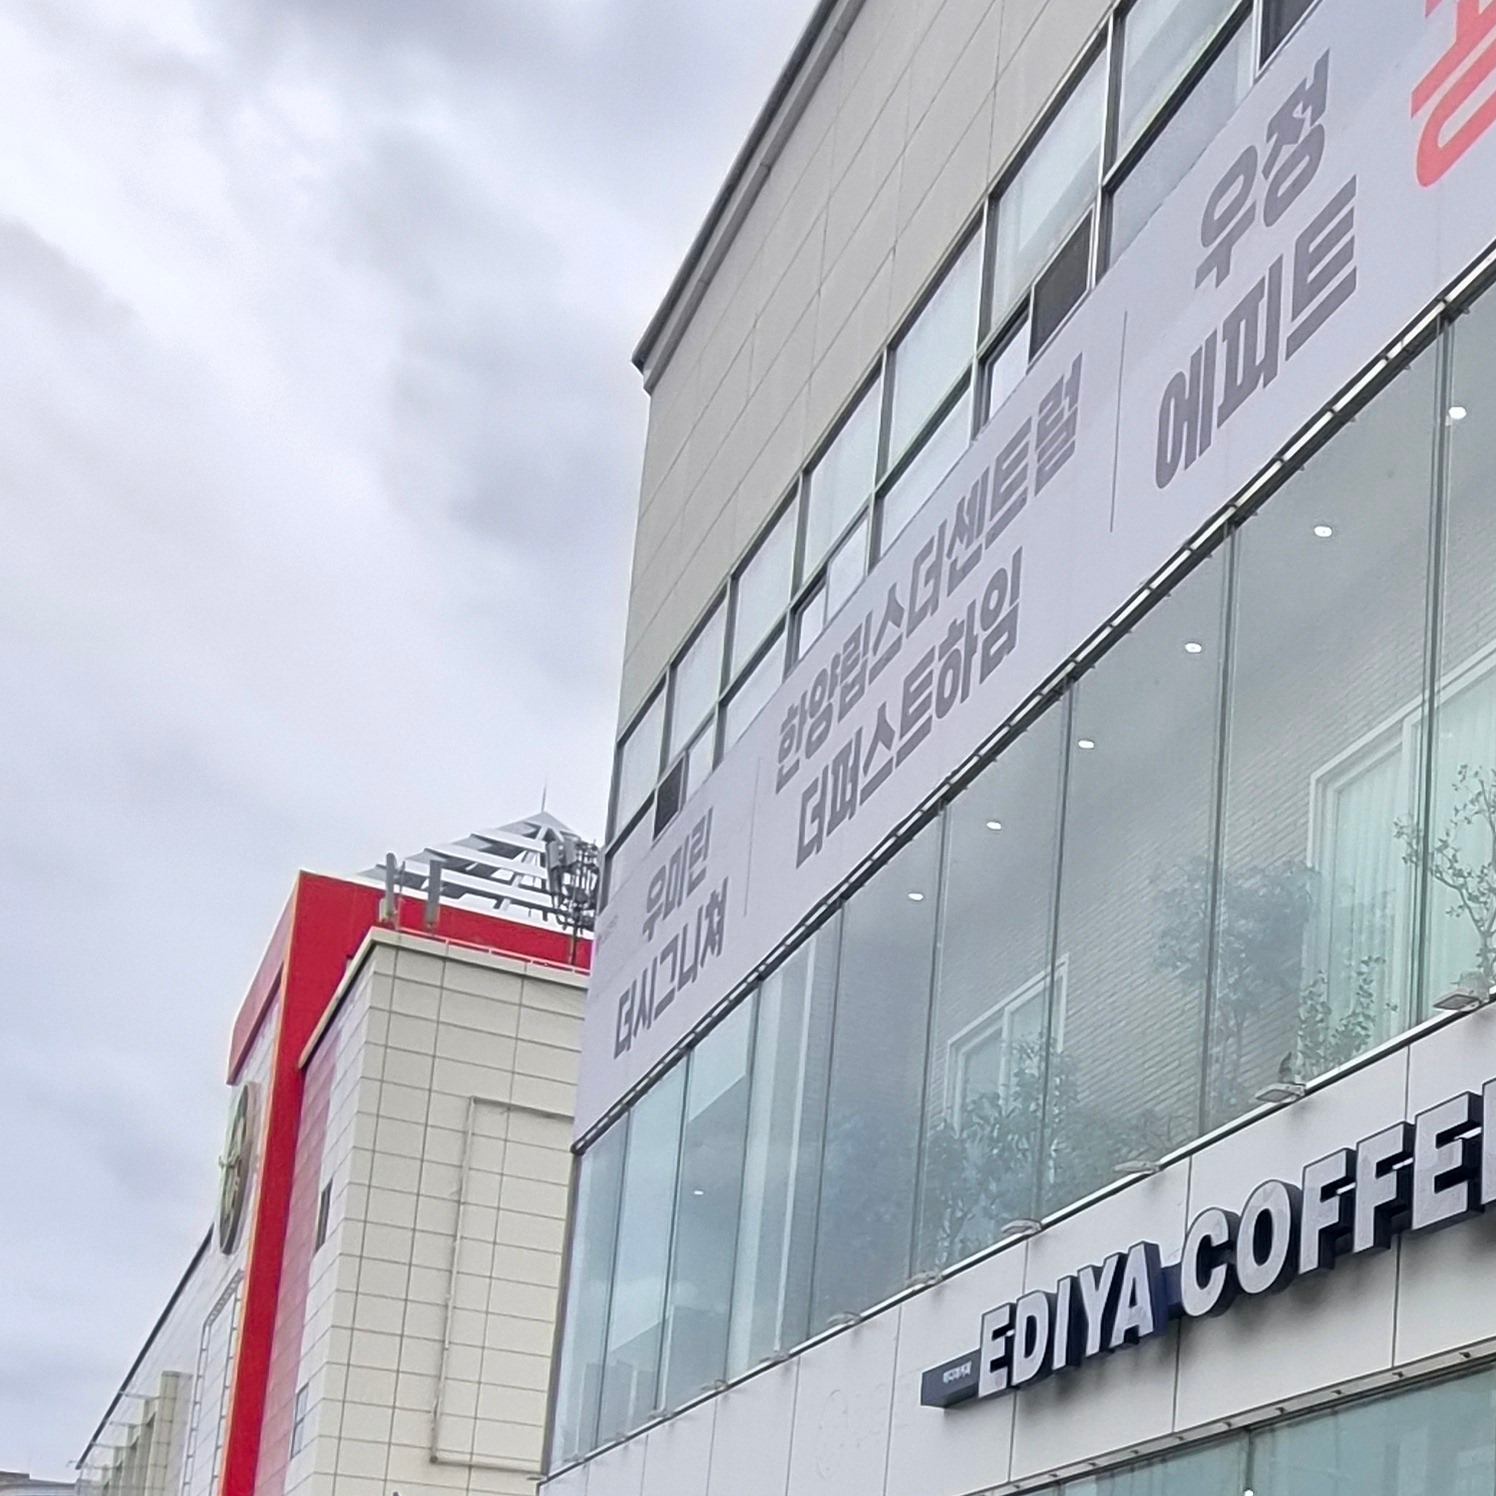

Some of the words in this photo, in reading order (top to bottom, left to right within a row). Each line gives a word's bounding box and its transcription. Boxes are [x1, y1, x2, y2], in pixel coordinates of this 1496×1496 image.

[1195, 48, 1331, 289] 우정
[1155, 175, 1356, 488] 에피트
[796, 546, 1023, 868] 더퍼스트하임
[614, 876, 728, 1060] 더시그니처
[642, 805, 713, 942] 우미린
[979, 1239, 1160, 1398] EDIYA
